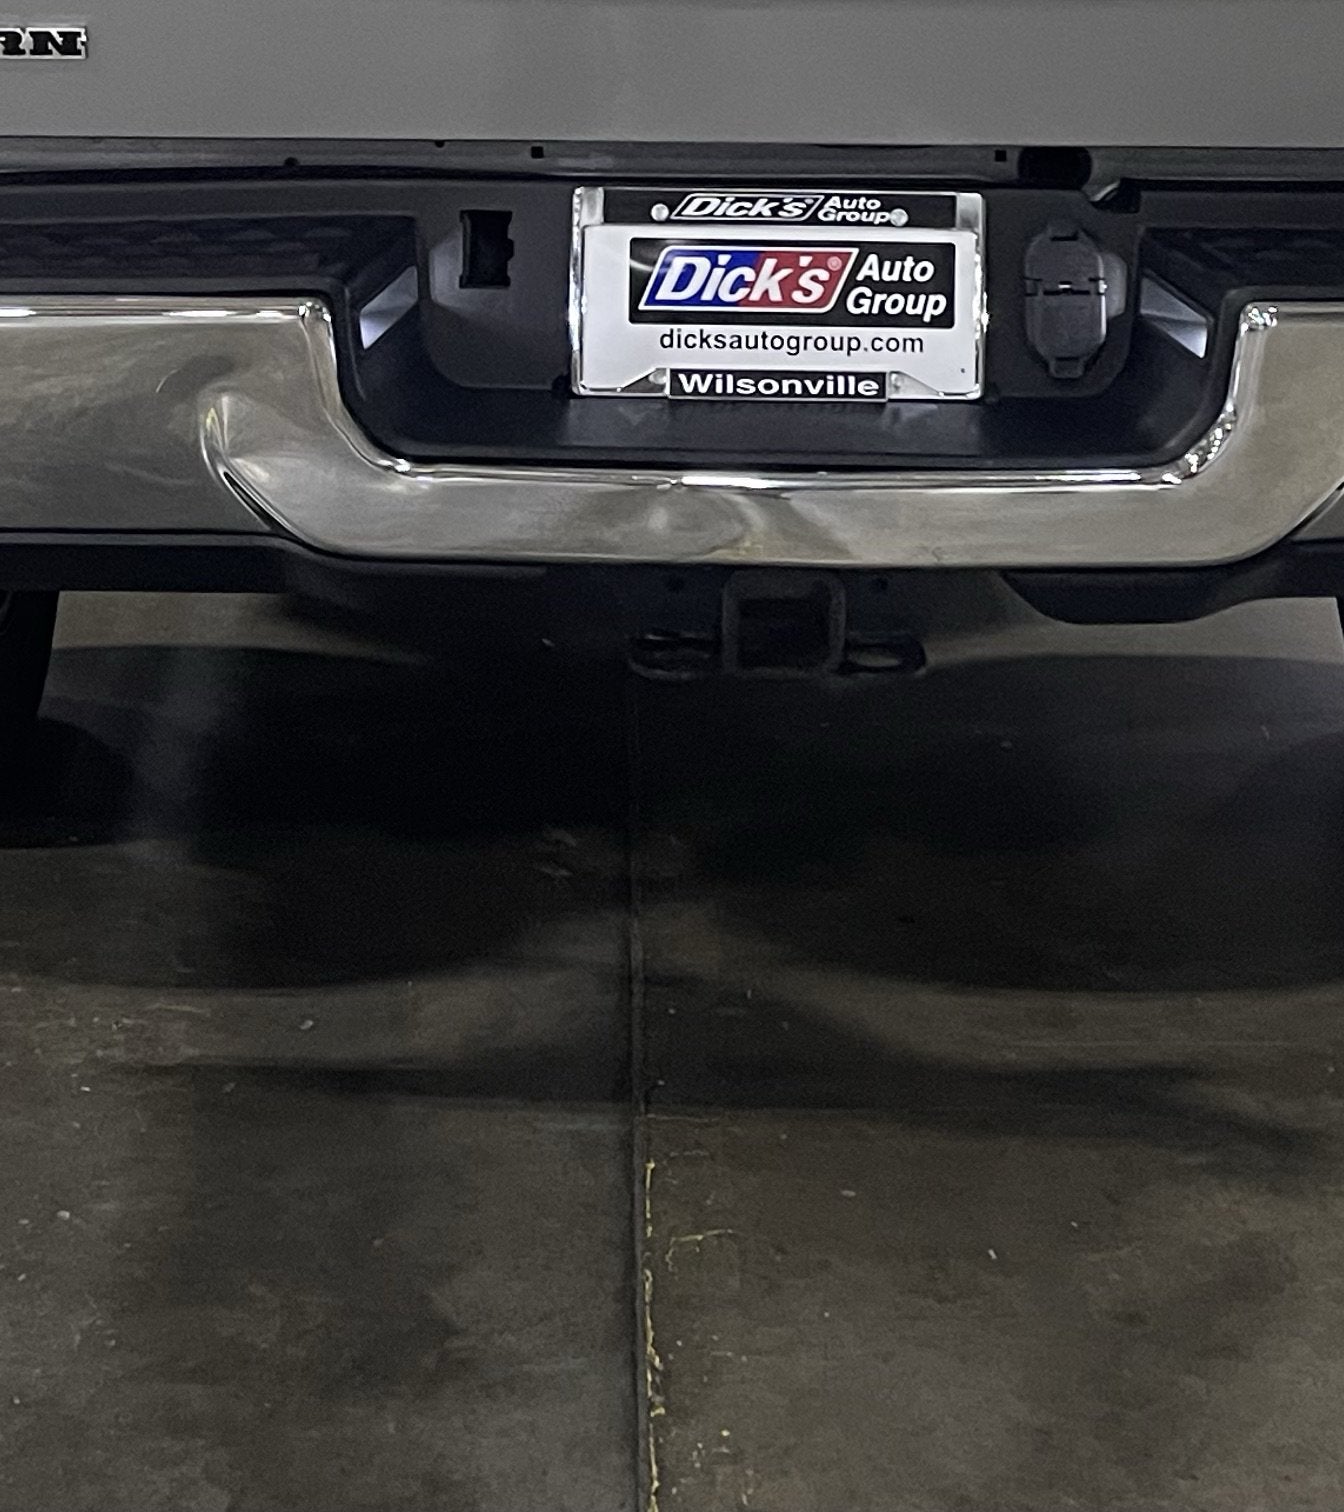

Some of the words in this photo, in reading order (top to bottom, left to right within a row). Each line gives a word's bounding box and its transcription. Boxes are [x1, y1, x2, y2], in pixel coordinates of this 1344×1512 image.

[680, 196, 809, 218] Dick's
[824, 196, 881, 210] Auto
[818, 208, 891, 224] Group
[655, 254, 831, 304] Dick's
[857, 254, 935, 283] Auto
[846, 287, 947, 323] Group
[659, 328, 924, 356] dicksautogroup.com
[678, 373, 880, 396] Wilsonville
